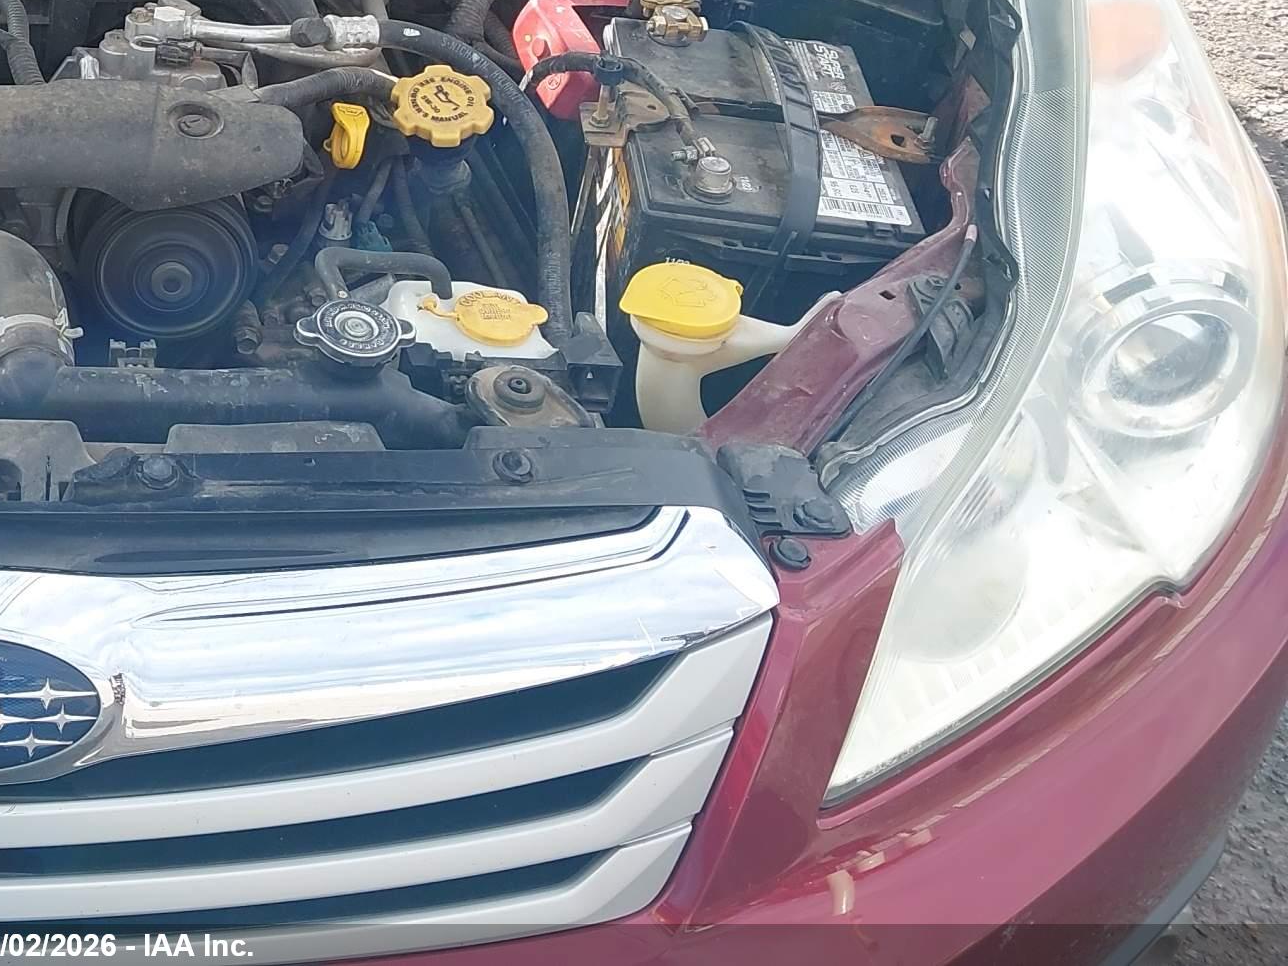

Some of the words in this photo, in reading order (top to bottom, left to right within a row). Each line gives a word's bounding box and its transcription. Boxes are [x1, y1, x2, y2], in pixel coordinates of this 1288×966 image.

[813, 43, 834, 79] START
[828, 49, 846, 80] SUPER
[440, 76, 473, 95] ENGINE
[466, 95, 476, 108] OIL
[430, 111, 469, 123] MANUAL
